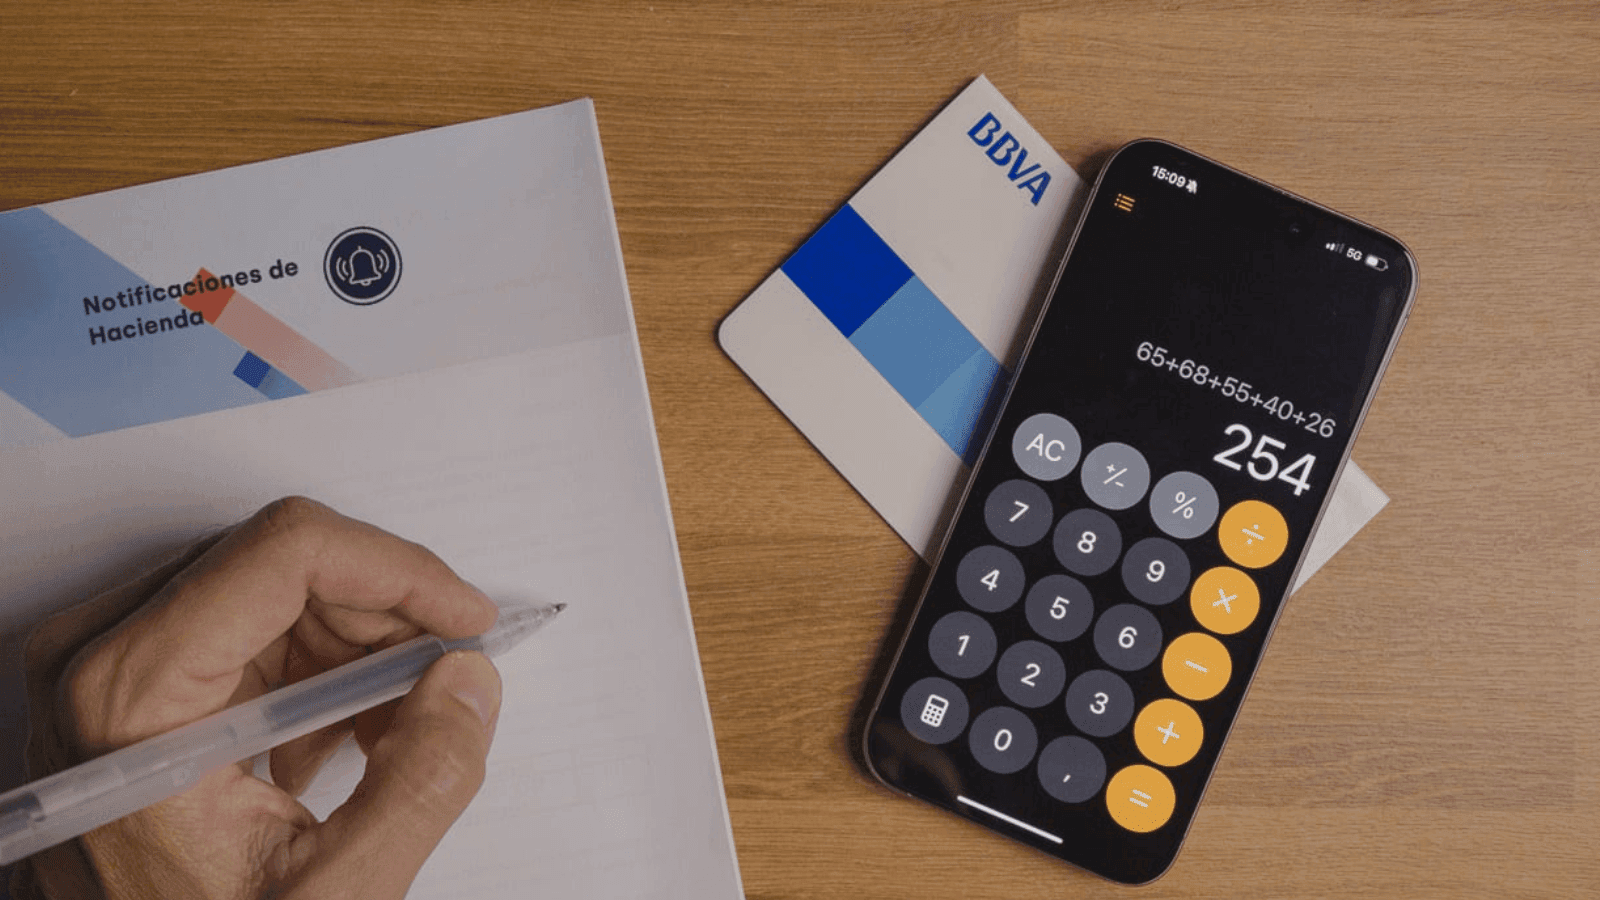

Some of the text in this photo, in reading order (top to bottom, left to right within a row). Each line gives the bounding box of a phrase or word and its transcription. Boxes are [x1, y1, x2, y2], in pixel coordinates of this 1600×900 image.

[967, 112, 1052, 206] BBVA
[1152, 165, 1186, 188] 15:09
[1346, 247, 1362, 261] 5G
[83, 259, 299, 315] Notificaciones de
[88, 309, 205, 345] Hacienda
[1136, 341, 1337, 438] 65+68+55+40+26
[1026, 433, 1065, 462] AC
[1213, 424, 1317, 496] 254
[1009, 500, 1030, 523] 7
[1172, 491, 1197, 519] %
[1077, 531, 1097, 554] 8
[981, 569, 1000, 591] 4
[1146, 560, 1165, 583] 9
[1050, 596, 1070, 619] 5
[957, 634, 970, 656] 1
[1118, 626, 1138, 649] 6
[1021, 663, 1041, 687] 2
[1090, 692, 1109, 715] 3
[994, 729, 1013, 751] 0
